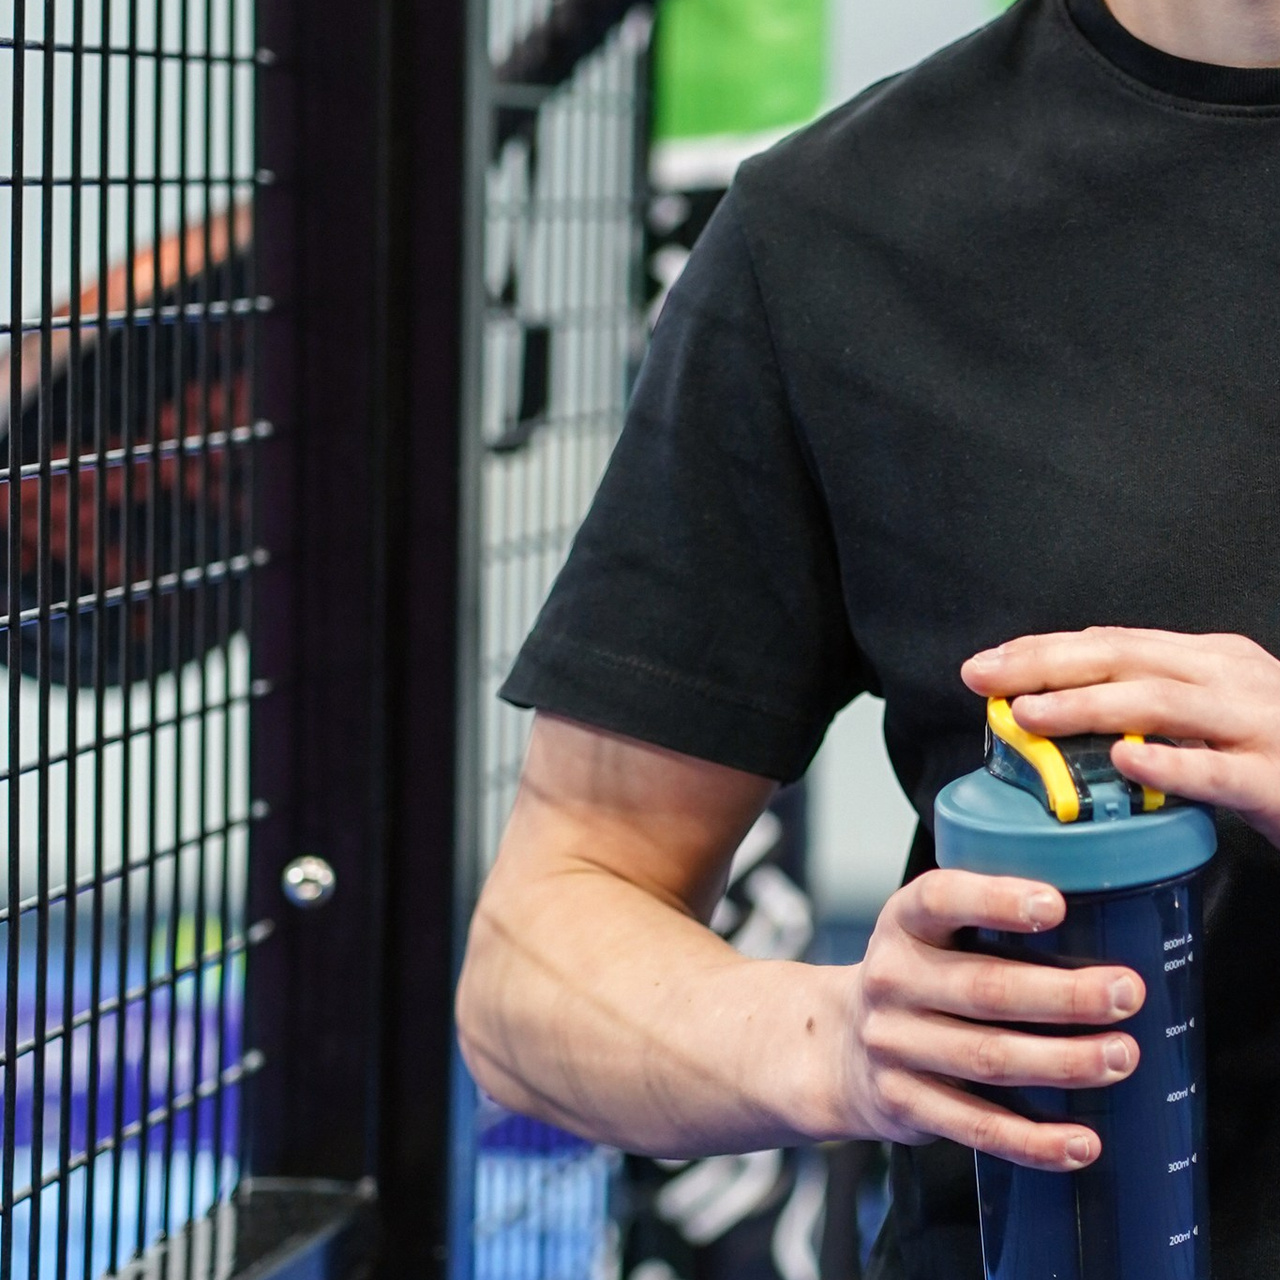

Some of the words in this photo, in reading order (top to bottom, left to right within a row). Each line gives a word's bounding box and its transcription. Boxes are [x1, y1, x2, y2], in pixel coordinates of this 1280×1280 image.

[1163, 935, 1186, 951] 800ml
[1164, 956, 1186, 972] 600ml
[1165, 1022, 1187, 1038] 500ml
[1166, 1087, 1189, 1103] 400ml
[1167, 1157, 1190, 1174] 300ml
[1169, 1230, 1191, 1247] 200ml
